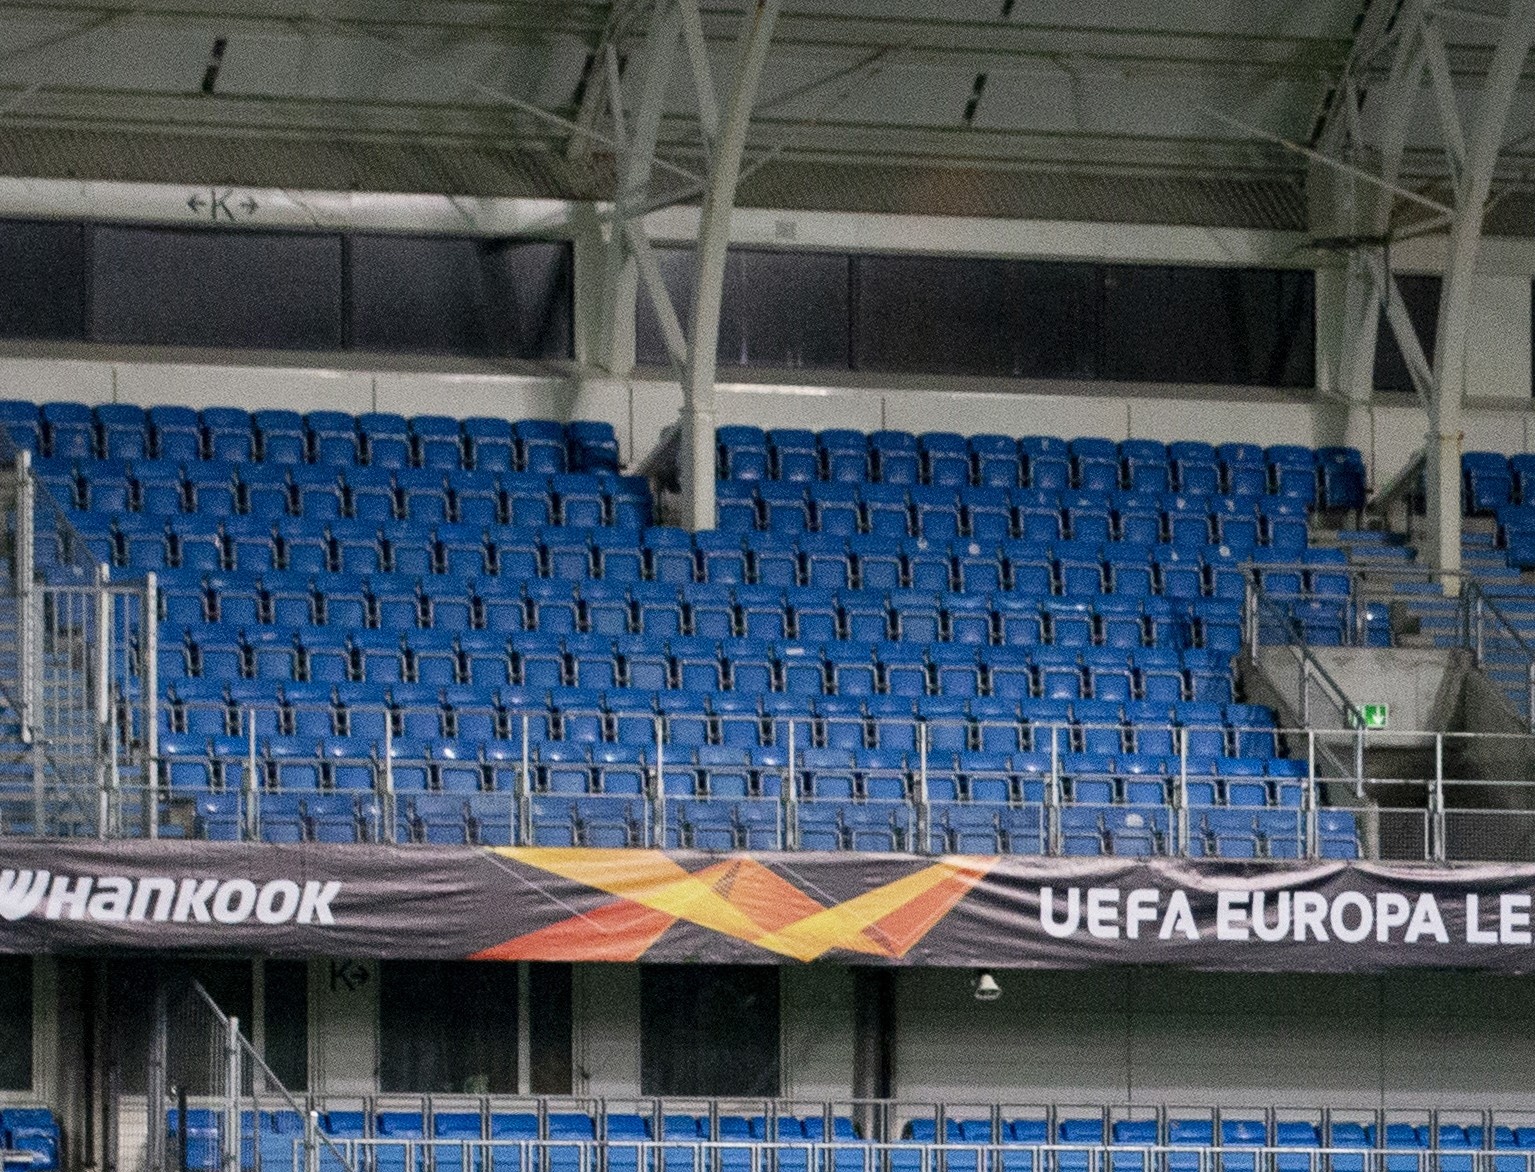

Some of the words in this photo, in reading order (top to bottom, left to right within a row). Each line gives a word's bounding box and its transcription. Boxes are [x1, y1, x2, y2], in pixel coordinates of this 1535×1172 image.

[211, 189, 236, 221] K
[1039, 887, 1199, 940] UEFA
[1216, 891, 1448, 943] EUROPA
[329, 960, 355, 991] K
